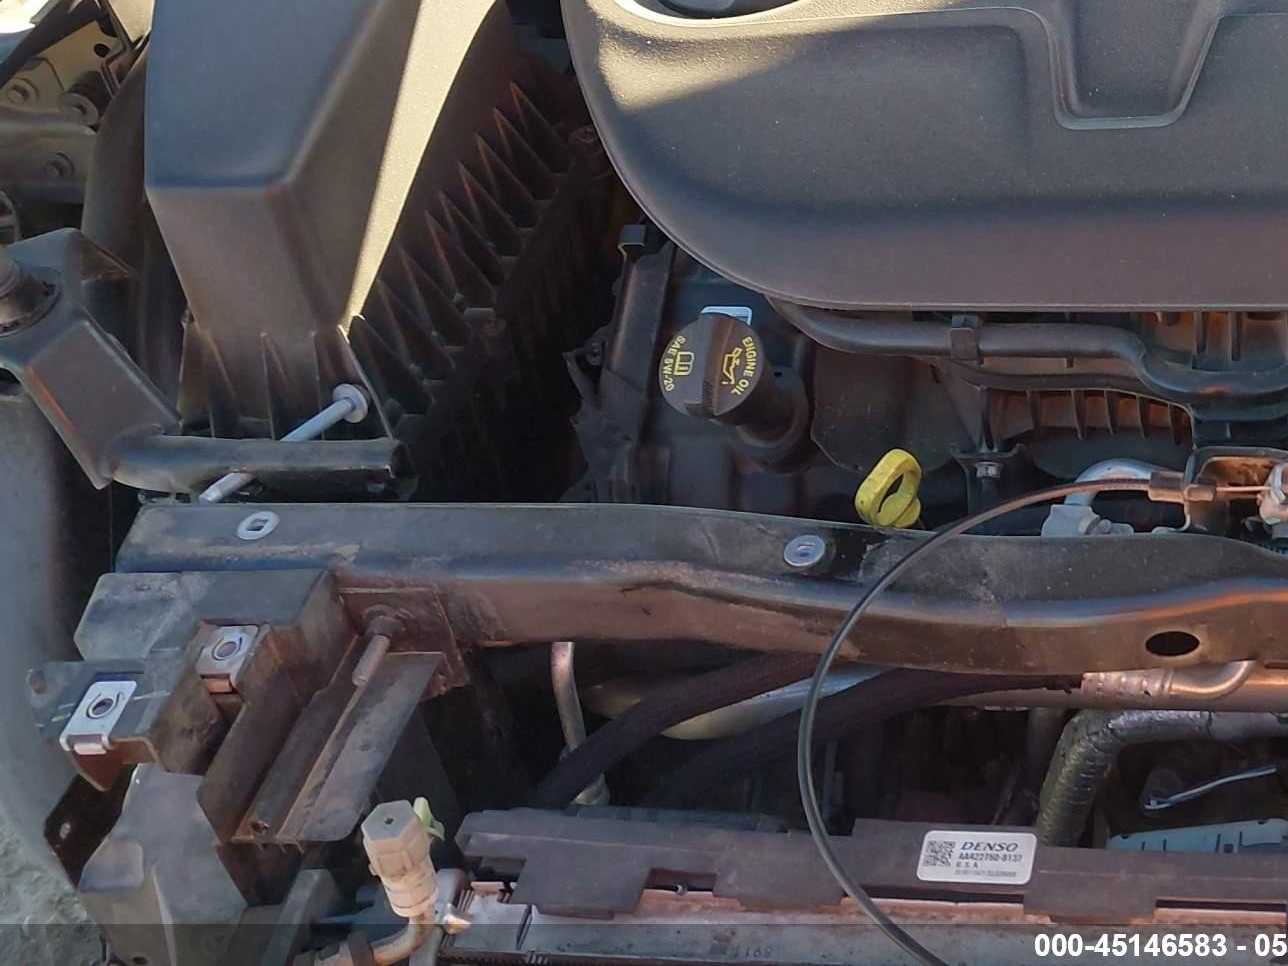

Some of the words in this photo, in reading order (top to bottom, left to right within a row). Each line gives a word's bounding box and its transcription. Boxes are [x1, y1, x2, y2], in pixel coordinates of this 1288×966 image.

[667, 335, 686, 356] SAE
[742, 336, 757, 378] ENGINE
[730, 378, 749, 395] OIL
[960, 841, 1019, 852] DENSO
